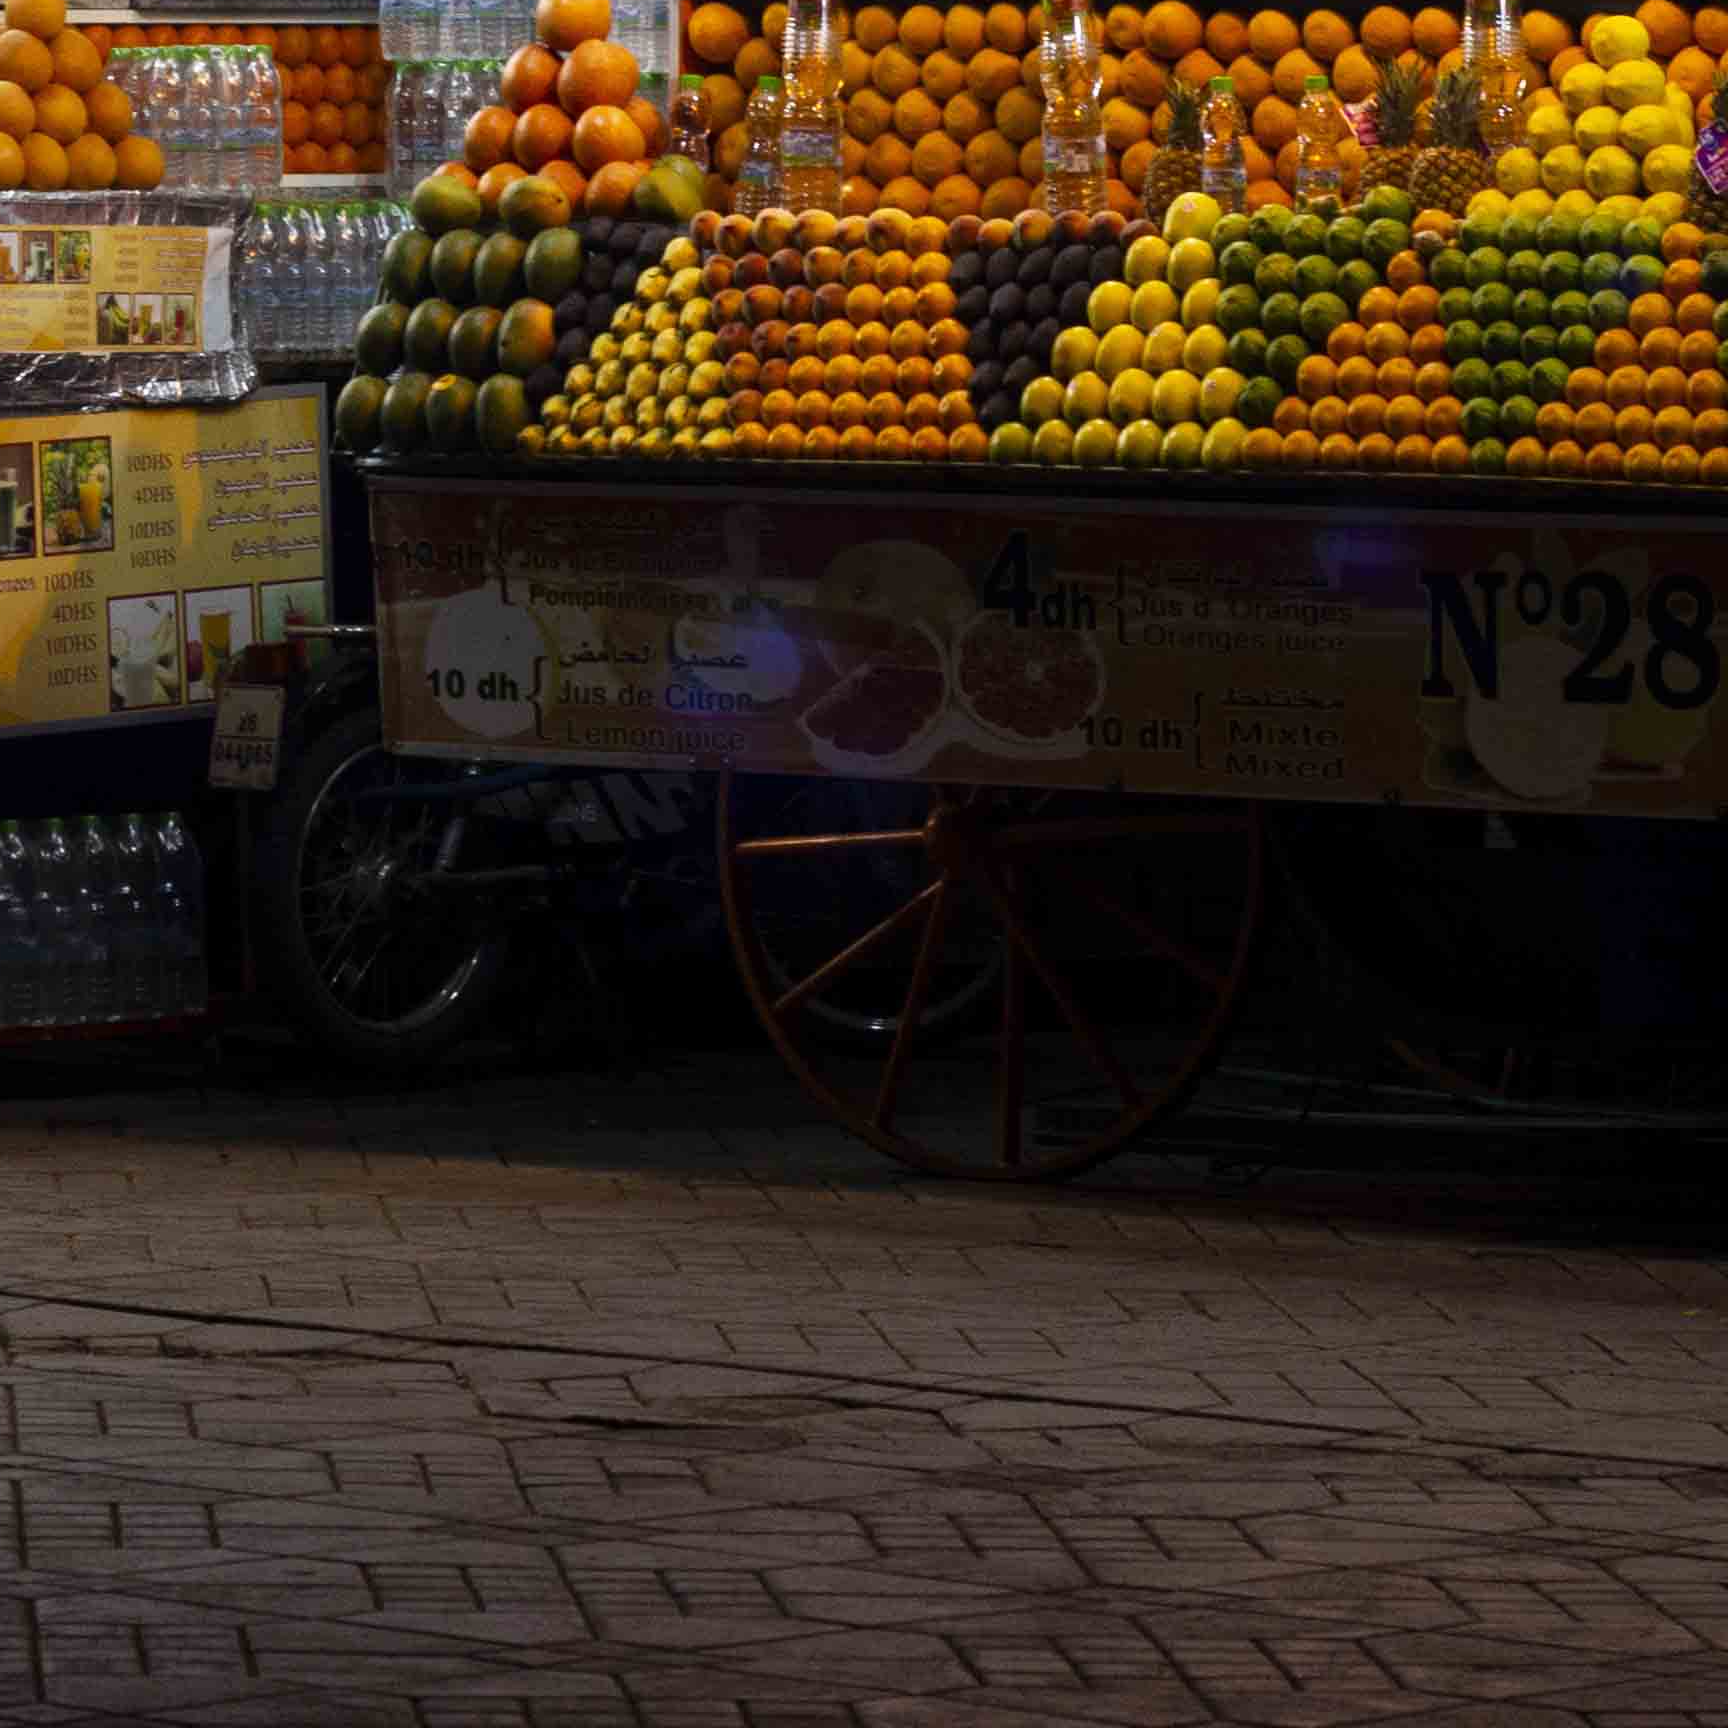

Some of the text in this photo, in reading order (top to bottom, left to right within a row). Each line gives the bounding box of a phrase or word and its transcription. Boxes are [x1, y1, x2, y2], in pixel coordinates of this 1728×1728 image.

[429, 668, 520, 703] 10 dh
[559, 681, 754, 712] Jus de Citron
[1139, 718, 1184, 750] dh
